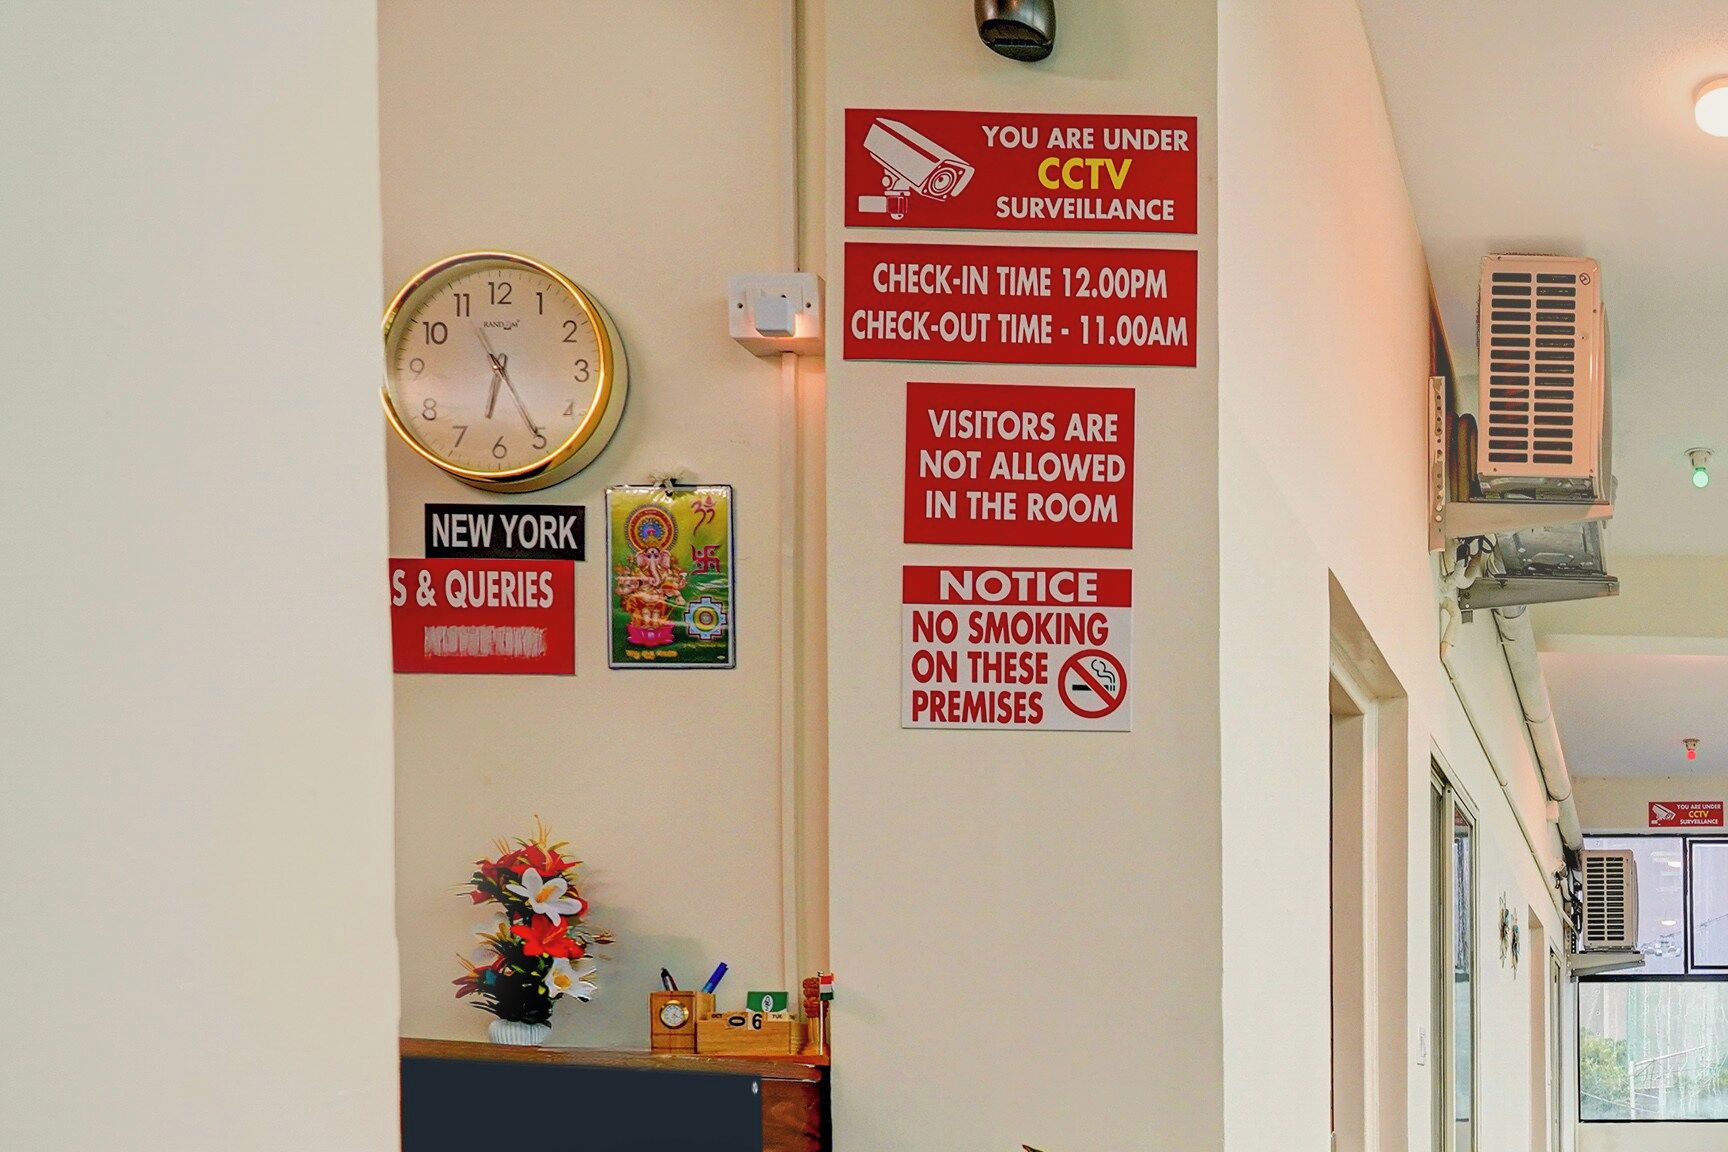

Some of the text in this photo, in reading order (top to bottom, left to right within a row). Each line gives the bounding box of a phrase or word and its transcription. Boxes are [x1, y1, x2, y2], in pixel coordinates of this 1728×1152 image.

[982, 125, 1190, 152] YOU ARE UNDER
[1037, 157, 1133, 190] CCTV
[995, 196, 1175, 221] SURVEILLANCE
[488, 281, 512, 305] 12
[873, 262, 1168, 299] CHECK-IN TIME 12.00PM
[453, 293, 470, 317] 11
[536, 292, 543, 315] 1
[422, 321, 448, 345] 10
[563, 319, 578, 343] 2
[851, 309, 990, 343] CHECK-OUT
[998, 313, 1052, 344] TIME
[1080, 315, 1188, 347] 11.00AM
[409, 357, 425, 381] 9
[574, 359, 590, 382] 3
[422, 398, 437, 421] 8
[452, 425, 469, 448] 7
[532, 427, 547, 450] 5
[927, 408, 1118, 443] VISITORS ARE
[492, 436, 507, 459] 6
[919, 449, 1126, 483] NOT ALLOWED
[925, 490, 1118, 523] IN THE ROOM
[432, 513, 577, 549] NEW YORK
[416, 569, 437, 608] &
[445, 569, 554, 609] QUERIES
[939, 570, 1098, 604] NOTICE
[912, 610, 1109, 646] NO SMOKING
[911, 649, 1049, 686] ON THESE
[911, 690, 1044, 725] PREMISES
